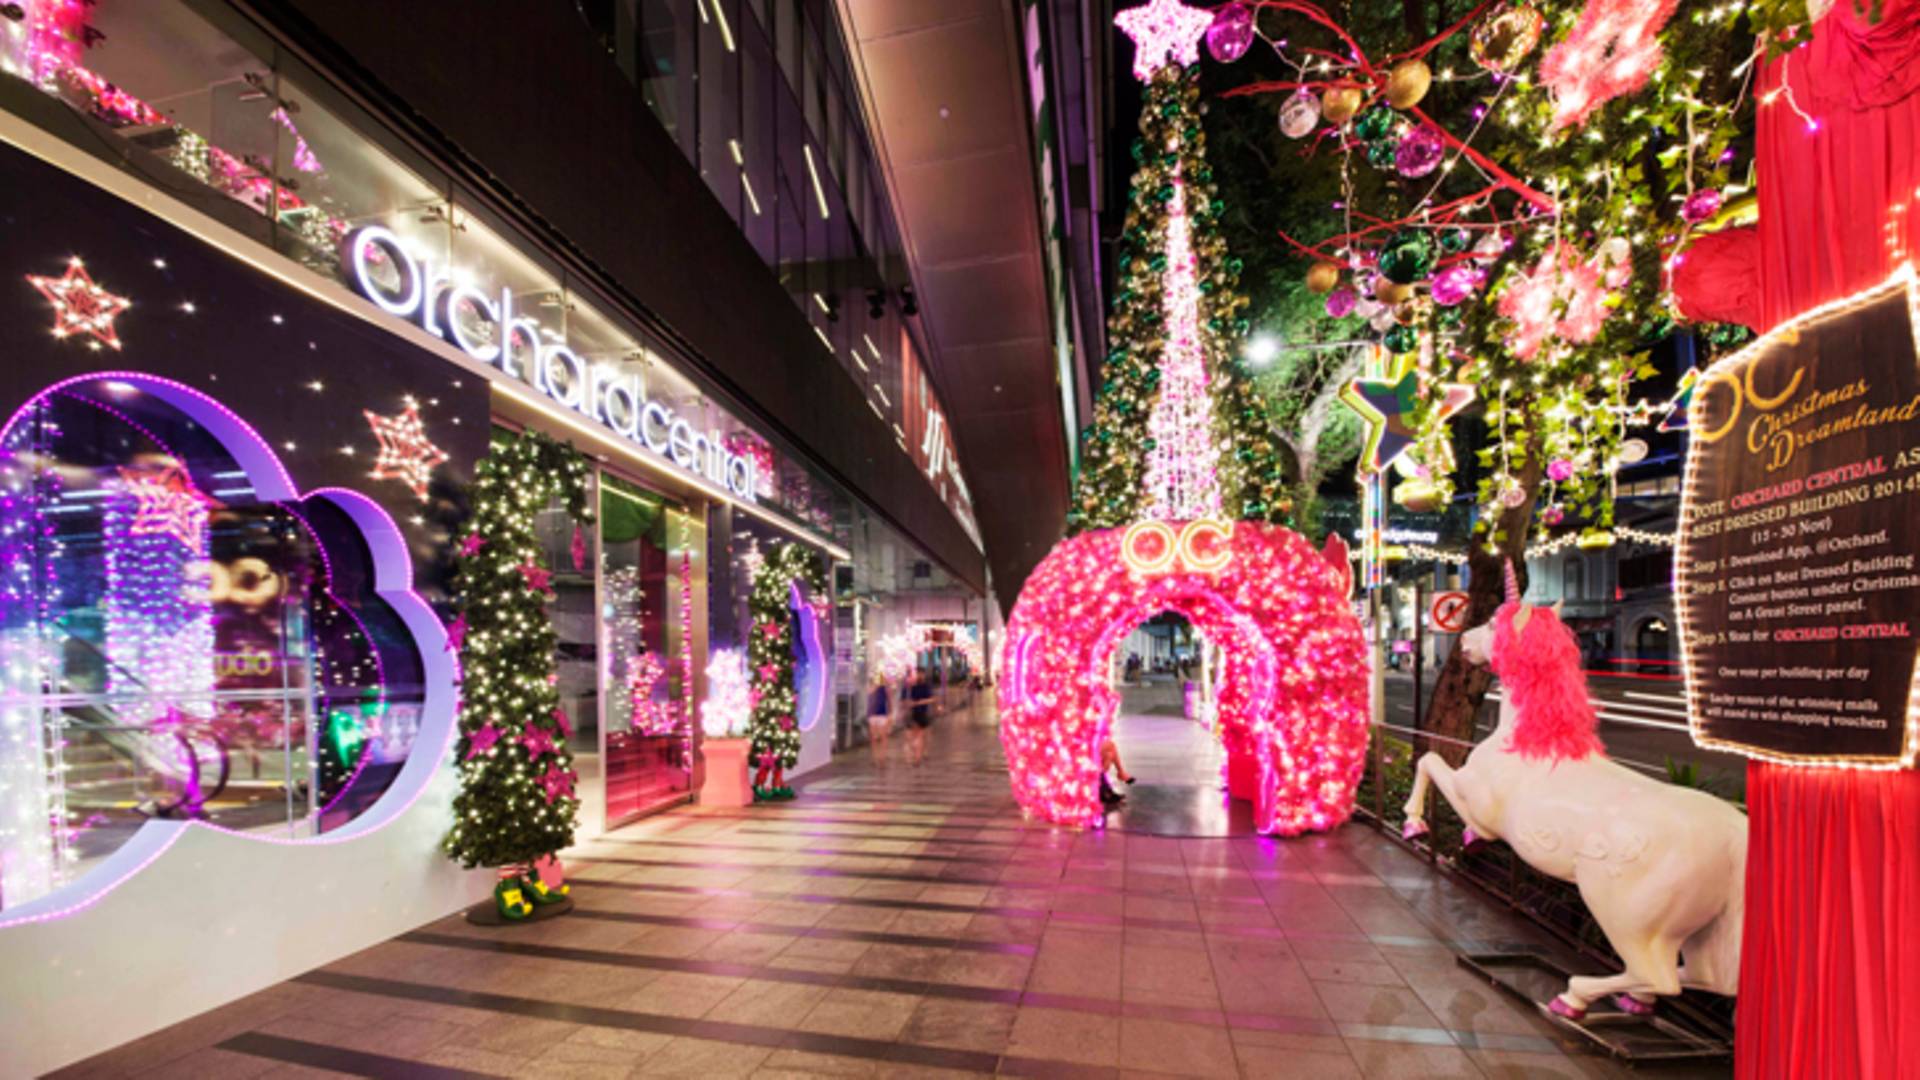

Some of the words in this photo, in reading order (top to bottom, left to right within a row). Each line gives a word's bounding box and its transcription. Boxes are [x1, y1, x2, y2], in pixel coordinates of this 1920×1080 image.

[1691, 326, 1805, 442] OC
[1747, 377, 1869, 453] Christmas
[1766, 394, 1920, 471] Dreamland
[1731, 479, 1803, 510] ORCHARD
[1806, 455, 1888, 491] CENTRAL
[1692, 519, 1722, 538] BEST
[1724, 505, 1787, 531] DRESSED
[1790, 484, 1870, 517] BUILDING
[1121, 515, 1235, 574] OC
[1751, 529, 1770, 546] (15
[1781, 523, 1797, 539] 30
[1799, 515, 1833, 536] Nov)
[1729, 575, 1756, 590] Click
[1758, 574, 1773, 587] on
[1774, 570, 1798, 584] Best
[1801, 560, 1850, 580] Dressed
[1852, 553, 1915, 574] Building
[1730, 547, 1784, 568] Download
[1729, 592, 1768, 605] Contest
[1771, 588, 1809, 601] button
[1811, 582, 1850, 597] under
[1729, 610, 1743, 621] on
[1745, 607, 1753, 620] A
[1755, 605, 1785, 619] Great
[1787, 602, 1822, 617] Street
[1728, 629, 1751, 642] Vote
[1753, 629, 1770, 642] for
[1774, 626, 1838, 642] ORCHARD
[1841, 622, 1910, 640] CENTRAL
[1718, 666, 1738, 678] One
[1739, 668, 1759, 678] vote
[1761, 668, 1778, 680] per
[1779, 666, 1822, 681] building
[1826, 668, 1844, 681] per
[1846, 665, 1870, 681] day
[1706, 706, 1722, 717] will
[1750, 711, 1759, 719] to
[1761, 711, 1779, 720] win
[1781, 711, 1829, 727] shopping
[1832, 715, 1888, 729] vouchers
[1709, 693, 1735, 706] Lucky
[1766, 696, 1778, 706] of
[1779, 696, 1796, 707] the
[1798, 697, 1843, 712] winning
[1845, 699, 1878, 712] malls
